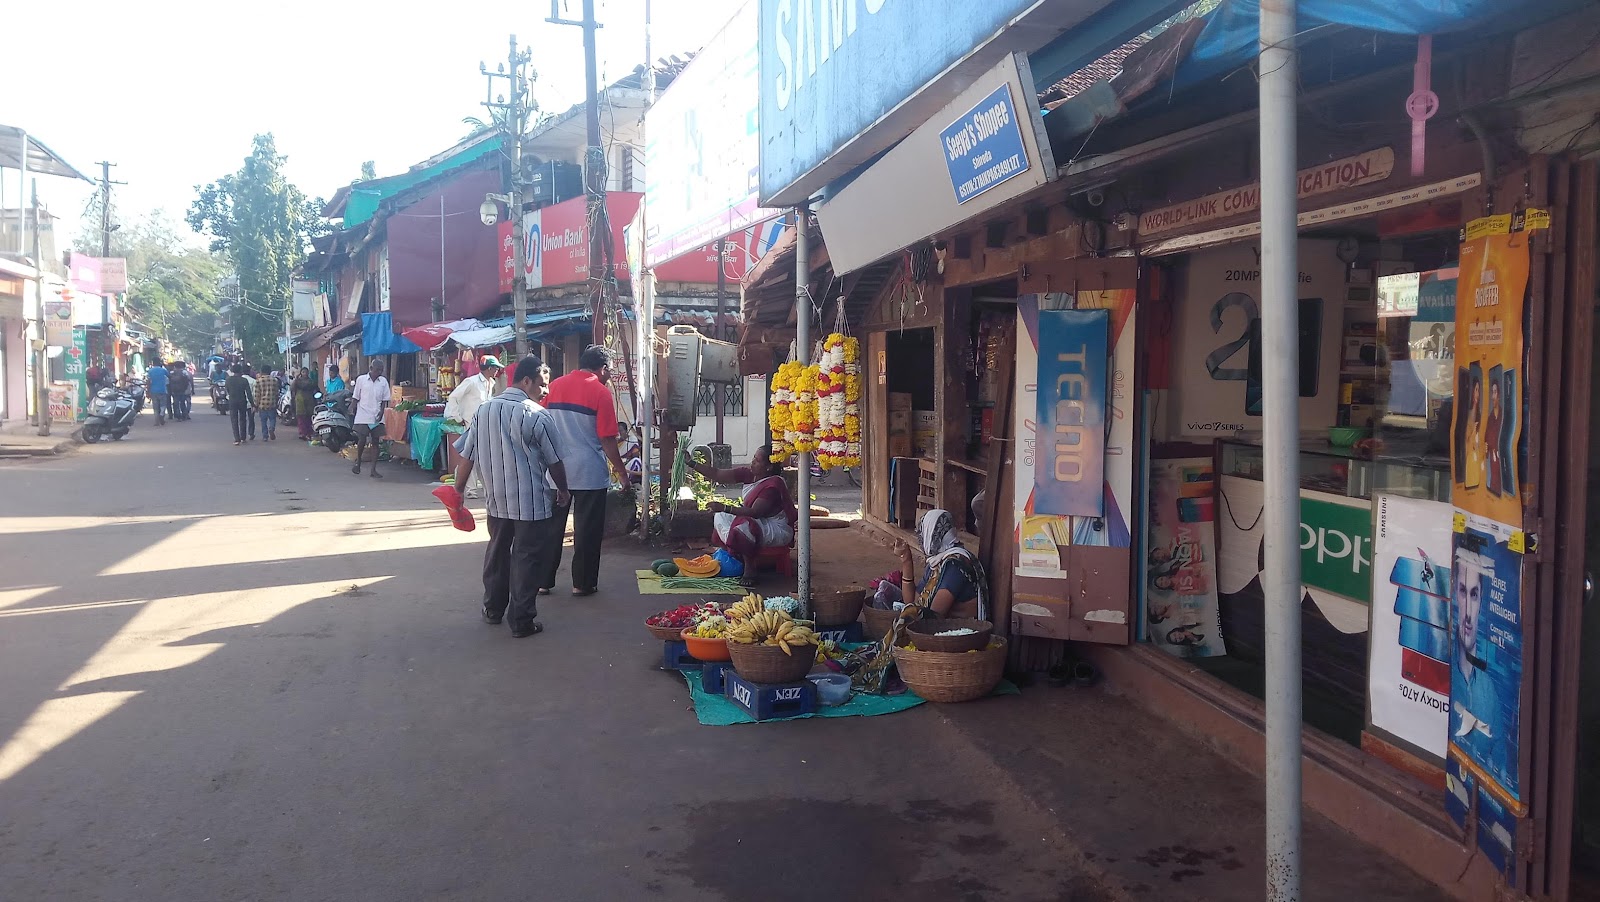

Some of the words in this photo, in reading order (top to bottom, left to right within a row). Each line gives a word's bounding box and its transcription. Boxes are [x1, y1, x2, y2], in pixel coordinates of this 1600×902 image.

[776, 0, 886, 111] SAM
[946, 122, 977, 161] Seeya's
[973, 100, 1009, 141] Shopee
[1145, 199, 1217, 230] WORLD-LINK
[543, 232, 562, 252] Union
[564, 226, 584, 247] Bank
[1221, 423, 1244, 431] SERIES
[1489, 589, 1504, 604] MADE
[819, 630, 846, 643] ZE
[732, 681, 751, 709] ZEN
[776, 687, 802, 701] ZEN
[1399, 683, 1420, 702] A70s
[1420, 690, 1450, 713] alaxy
